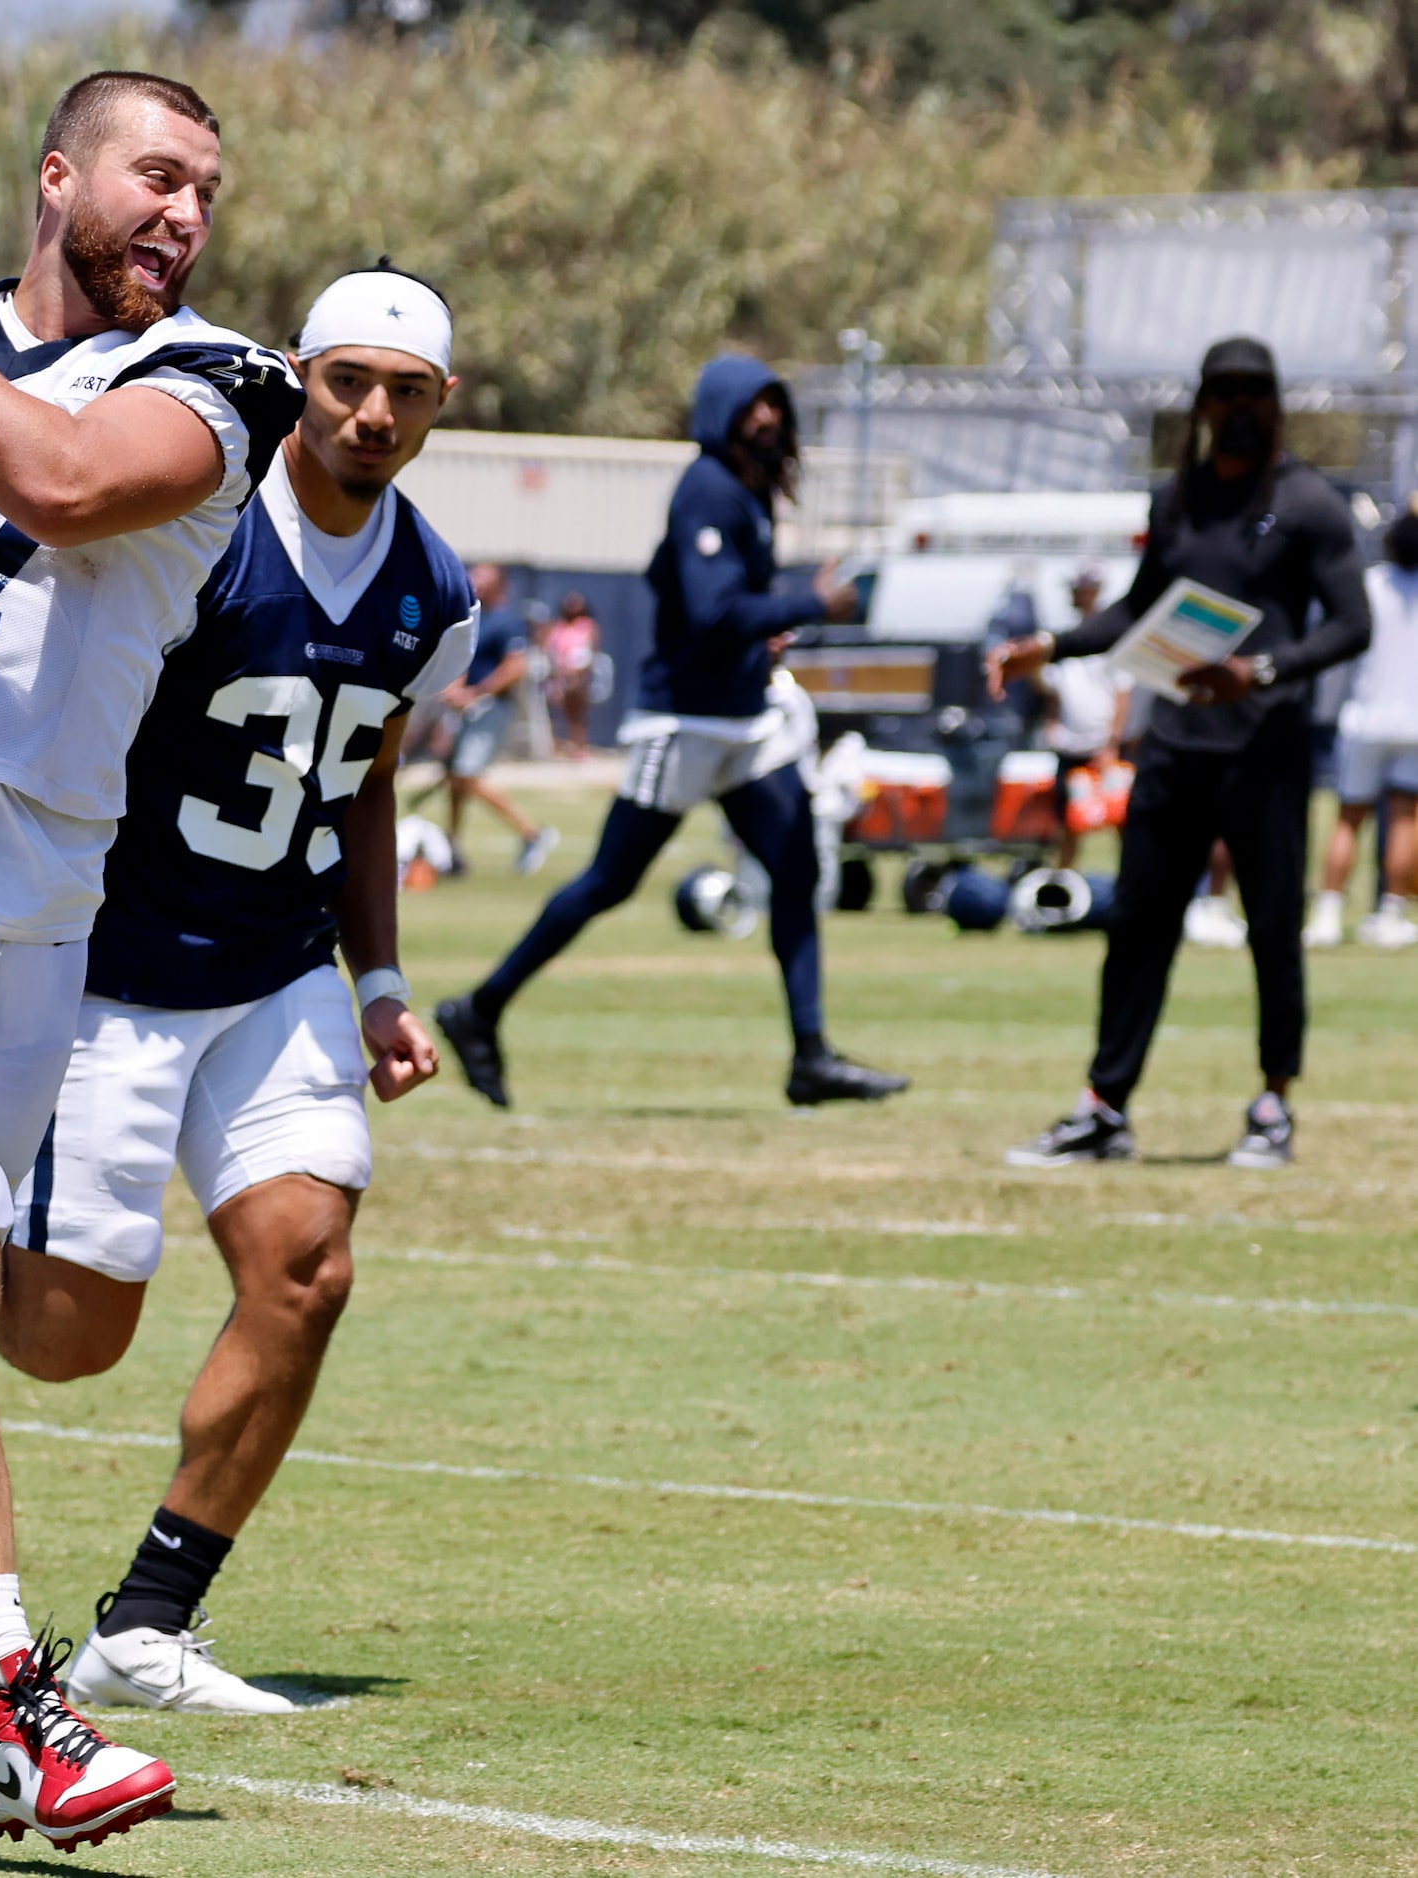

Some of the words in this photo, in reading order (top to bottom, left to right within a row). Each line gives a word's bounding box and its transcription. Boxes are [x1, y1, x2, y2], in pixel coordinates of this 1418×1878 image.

[69, 375, 108, 392] AT&T
[393, 630, 420, 651] AT&T
[177, 675, 402, 875] 35
